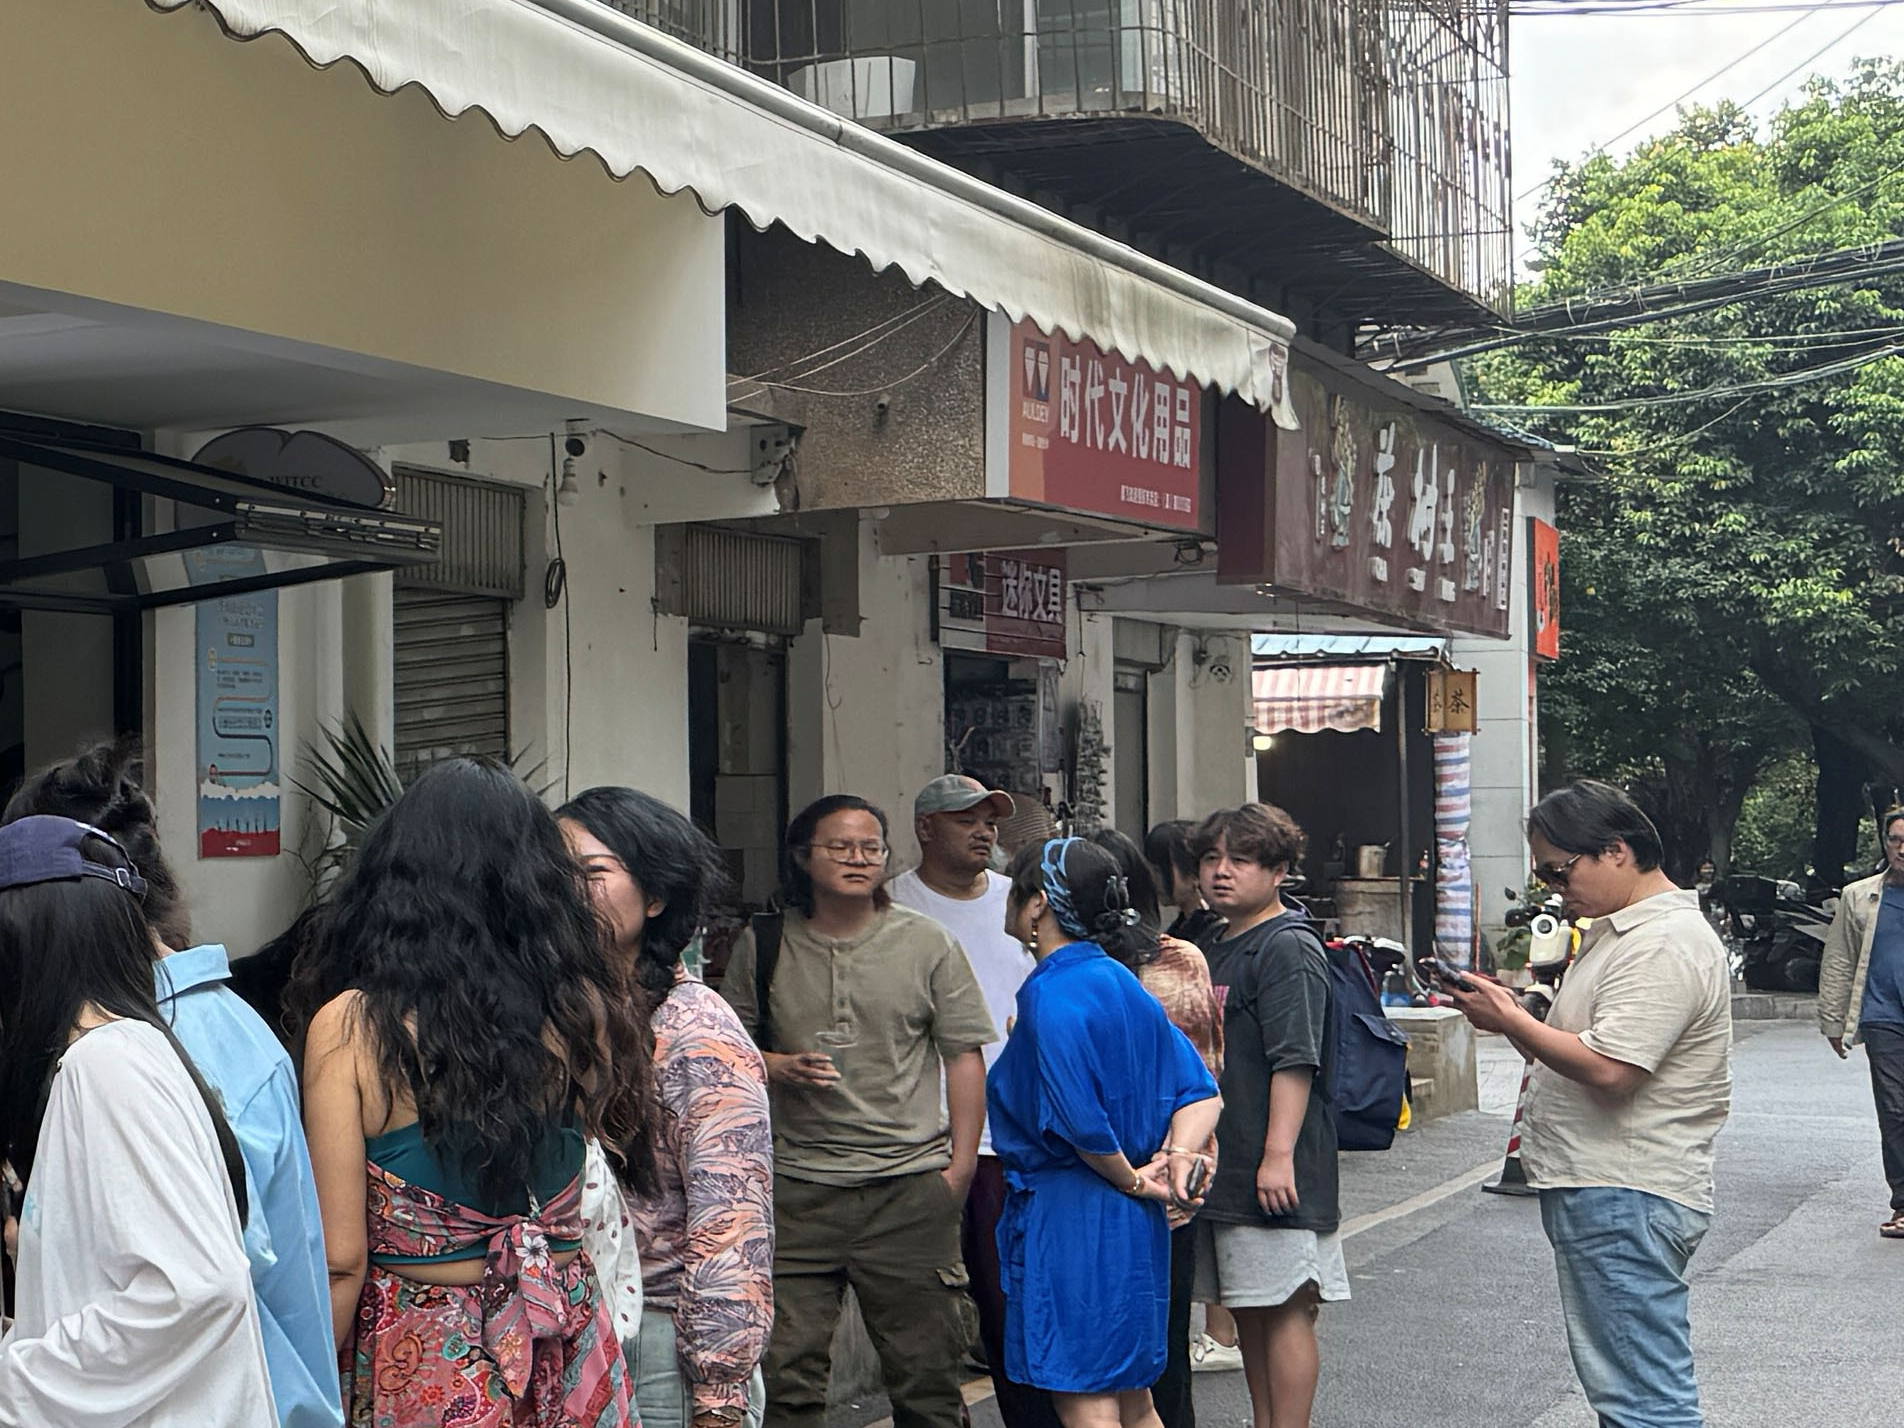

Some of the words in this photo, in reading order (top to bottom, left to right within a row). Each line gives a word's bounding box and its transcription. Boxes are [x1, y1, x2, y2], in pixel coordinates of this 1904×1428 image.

[1060, 355, 1191, 469] 时代文化用品
[1000, 560, 1063, 624] 迷你文具
[1448, 691, 1470, 714] 茶
